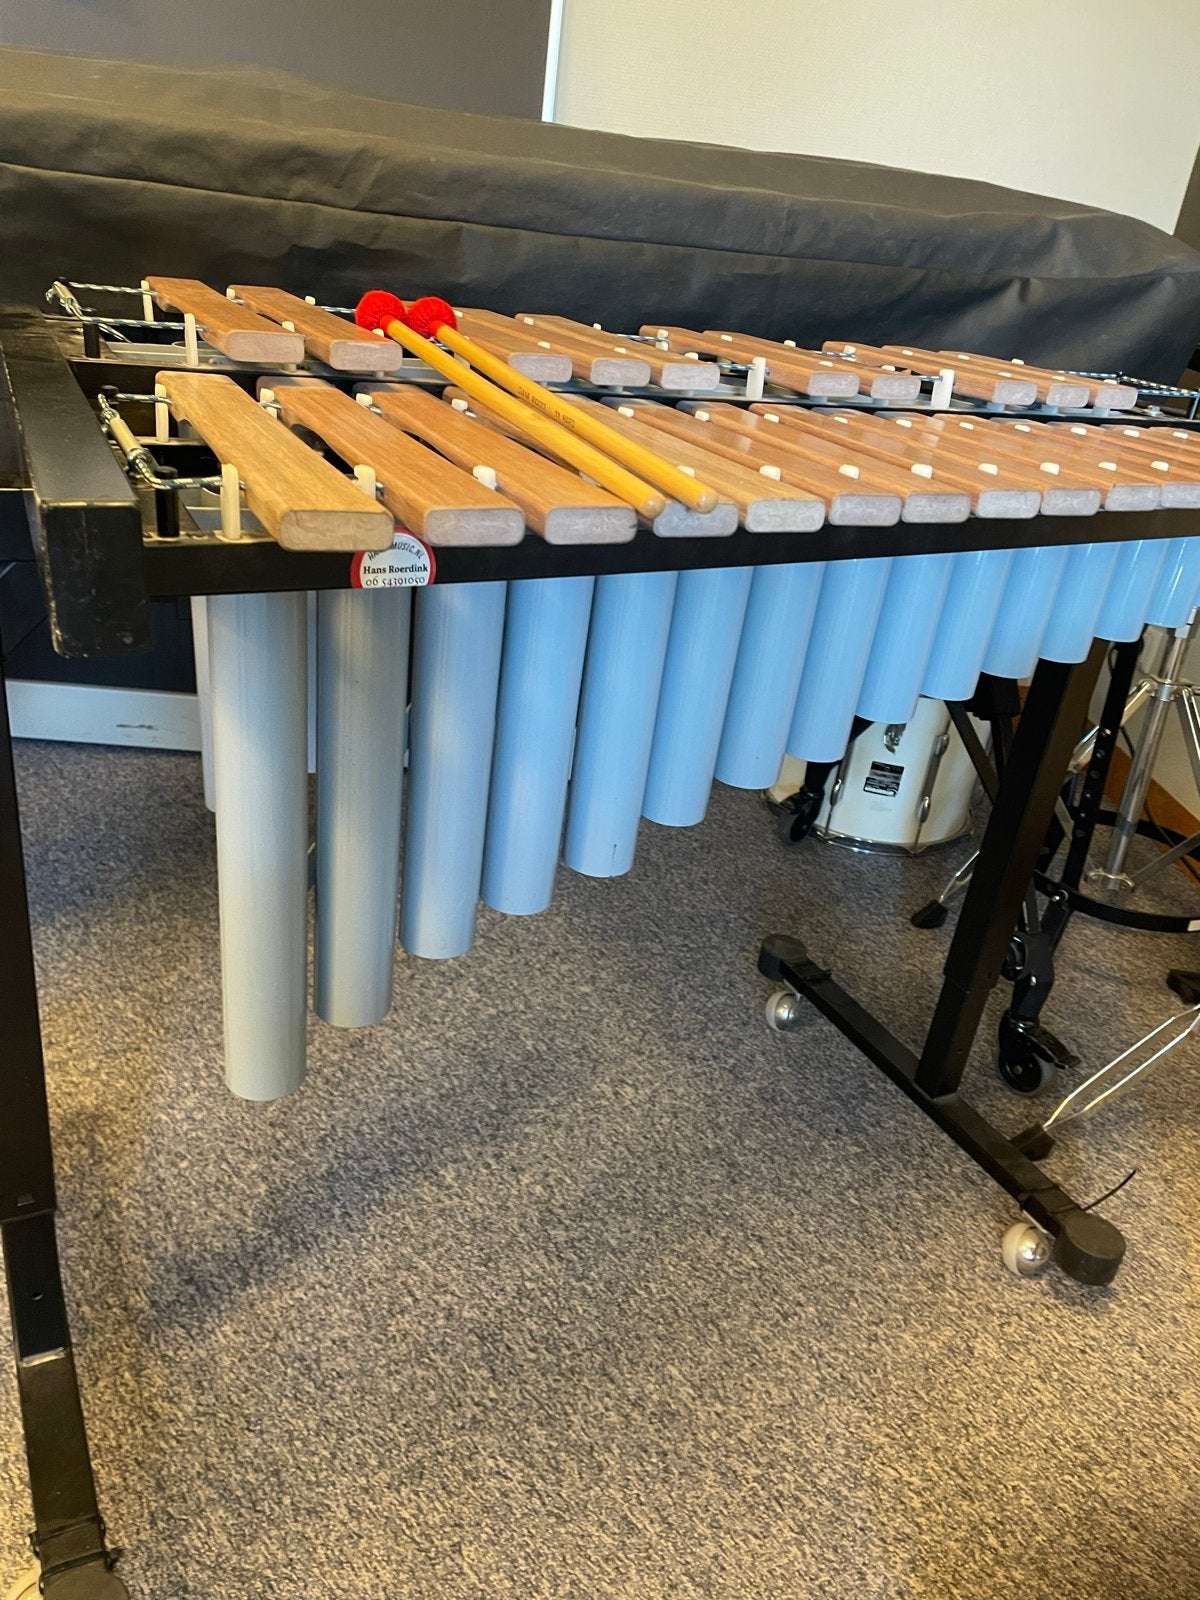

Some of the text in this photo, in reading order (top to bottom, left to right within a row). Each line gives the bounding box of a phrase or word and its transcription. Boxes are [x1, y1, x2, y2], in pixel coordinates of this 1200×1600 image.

[363, 563, 428, 574] Hans Roerdink
[365, 576, 379, 586] 06
